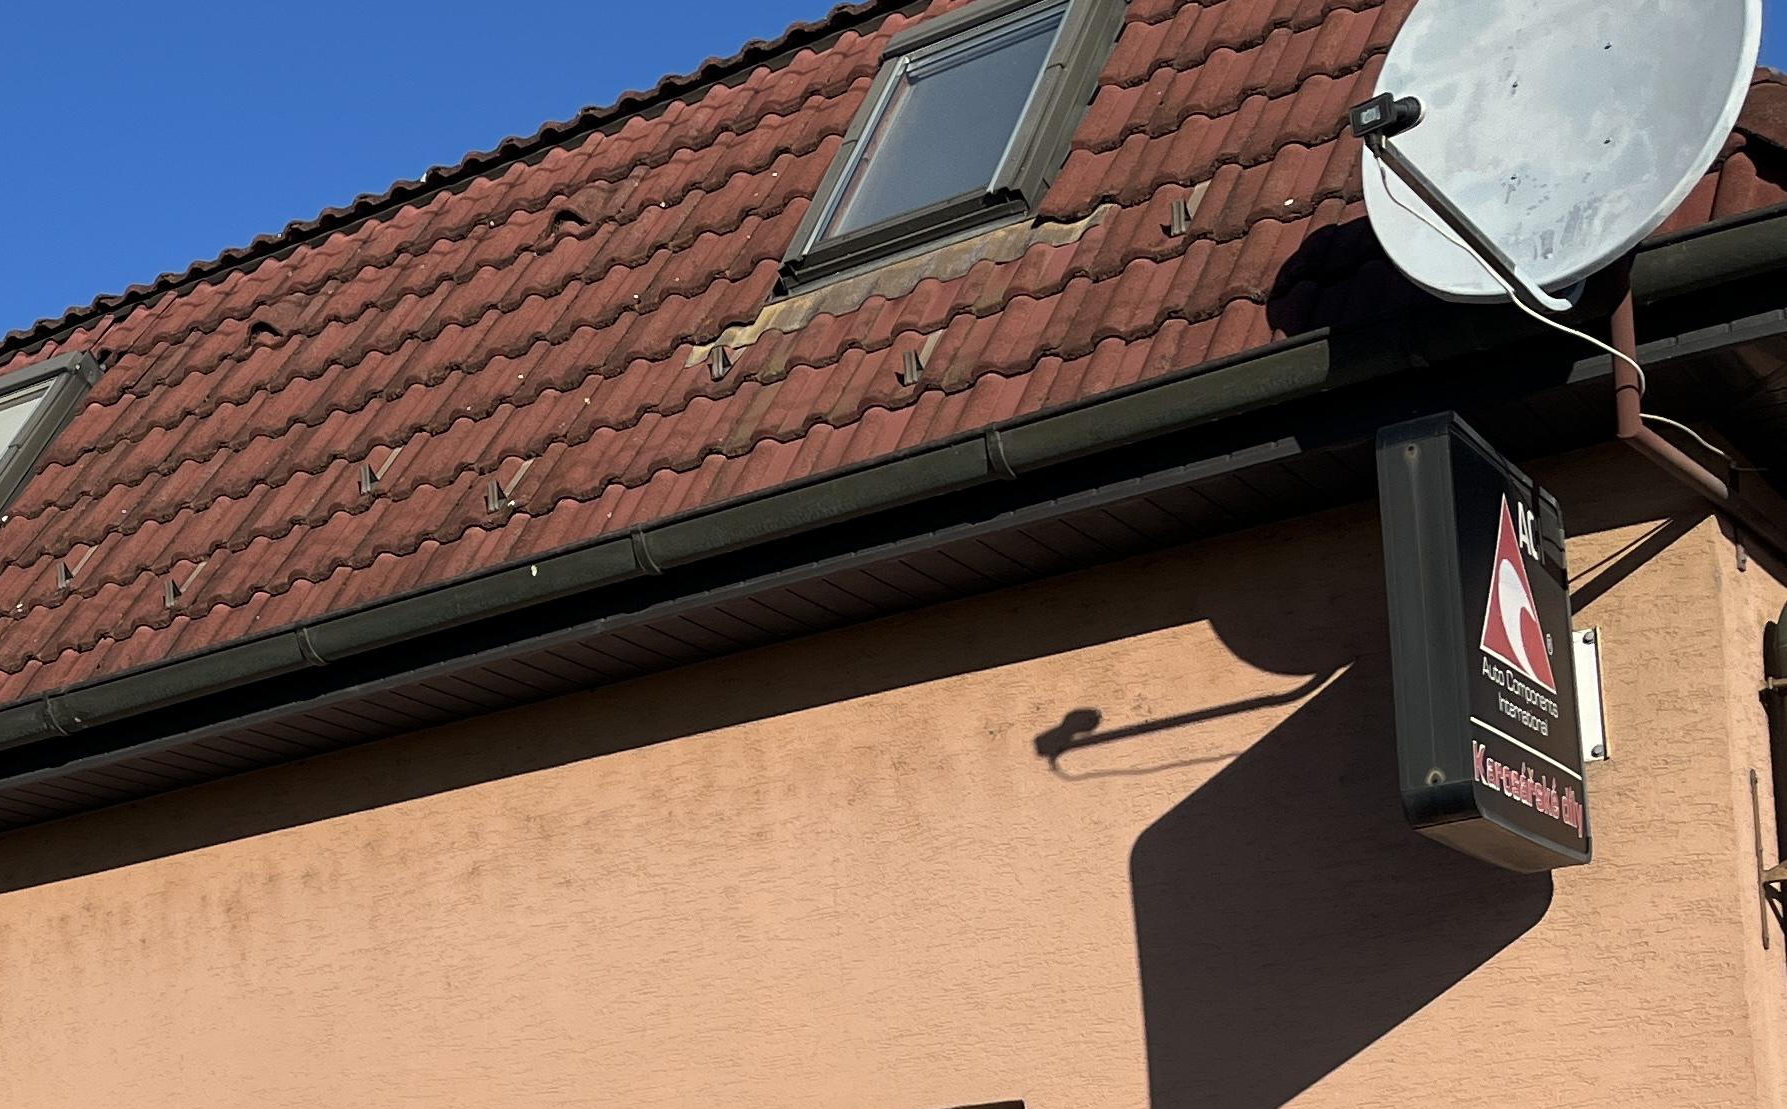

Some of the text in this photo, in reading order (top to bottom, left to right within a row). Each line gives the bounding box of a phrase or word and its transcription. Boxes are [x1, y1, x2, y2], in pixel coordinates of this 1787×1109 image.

[1482, 656, 1559, 719] Auto Components
[1498, 691, 1549, 737] International
